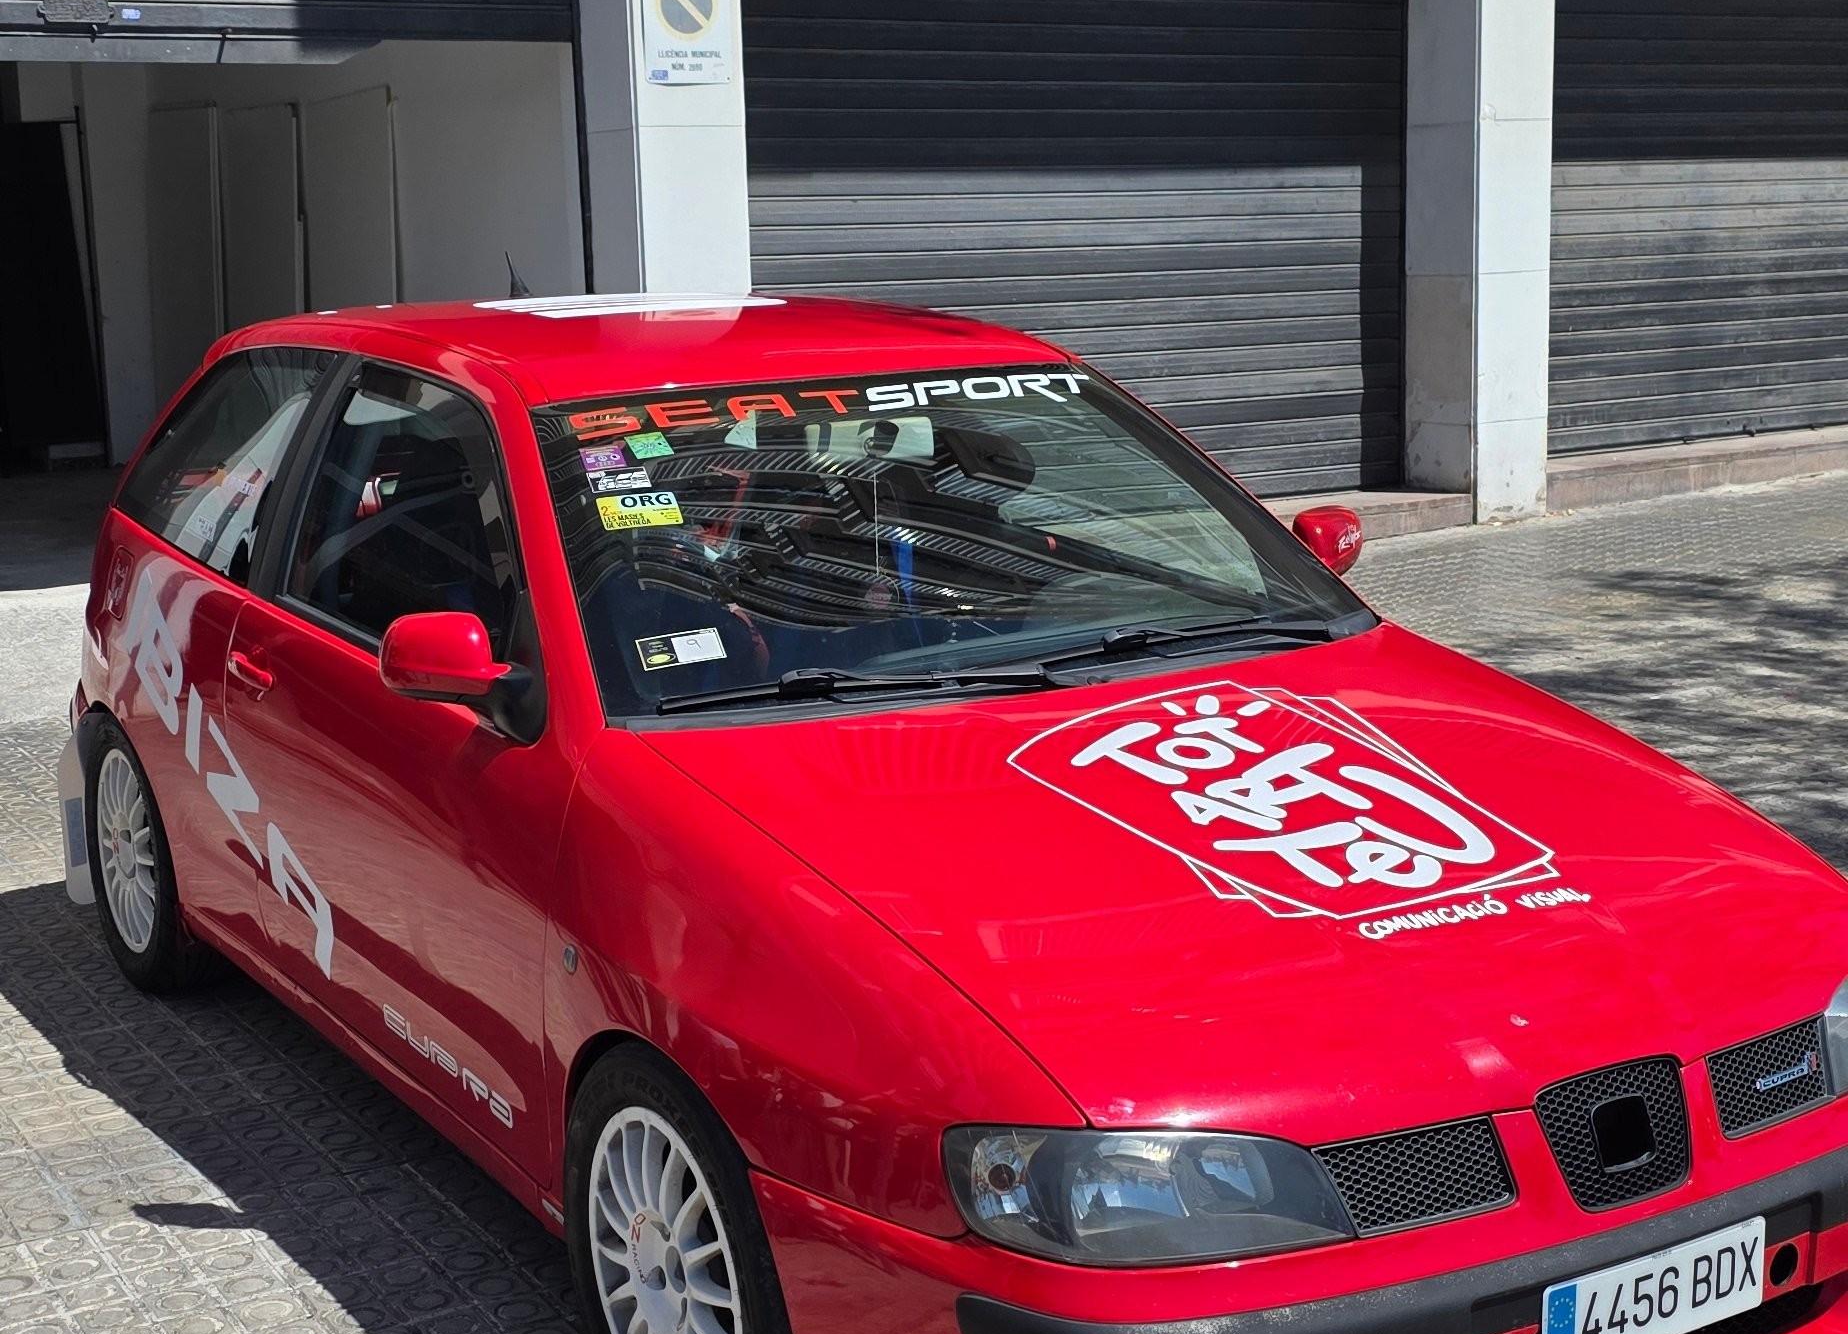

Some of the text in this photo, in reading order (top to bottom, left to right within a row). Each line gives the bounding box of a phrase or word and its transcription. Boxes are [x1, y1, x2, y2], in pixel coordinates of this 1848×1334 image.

[658, 49, 722, 59] LLICÈNCIA MUNICIPAL
[621, 493, 672, 508] ORG
[124, 565, 335, 981] IBIZA
[382, 1003, 514, 1129] CUPRA
[1762, 1068, 1805, 1089] CUPRA
[1691, 1236, 1759, 1310] BDX
